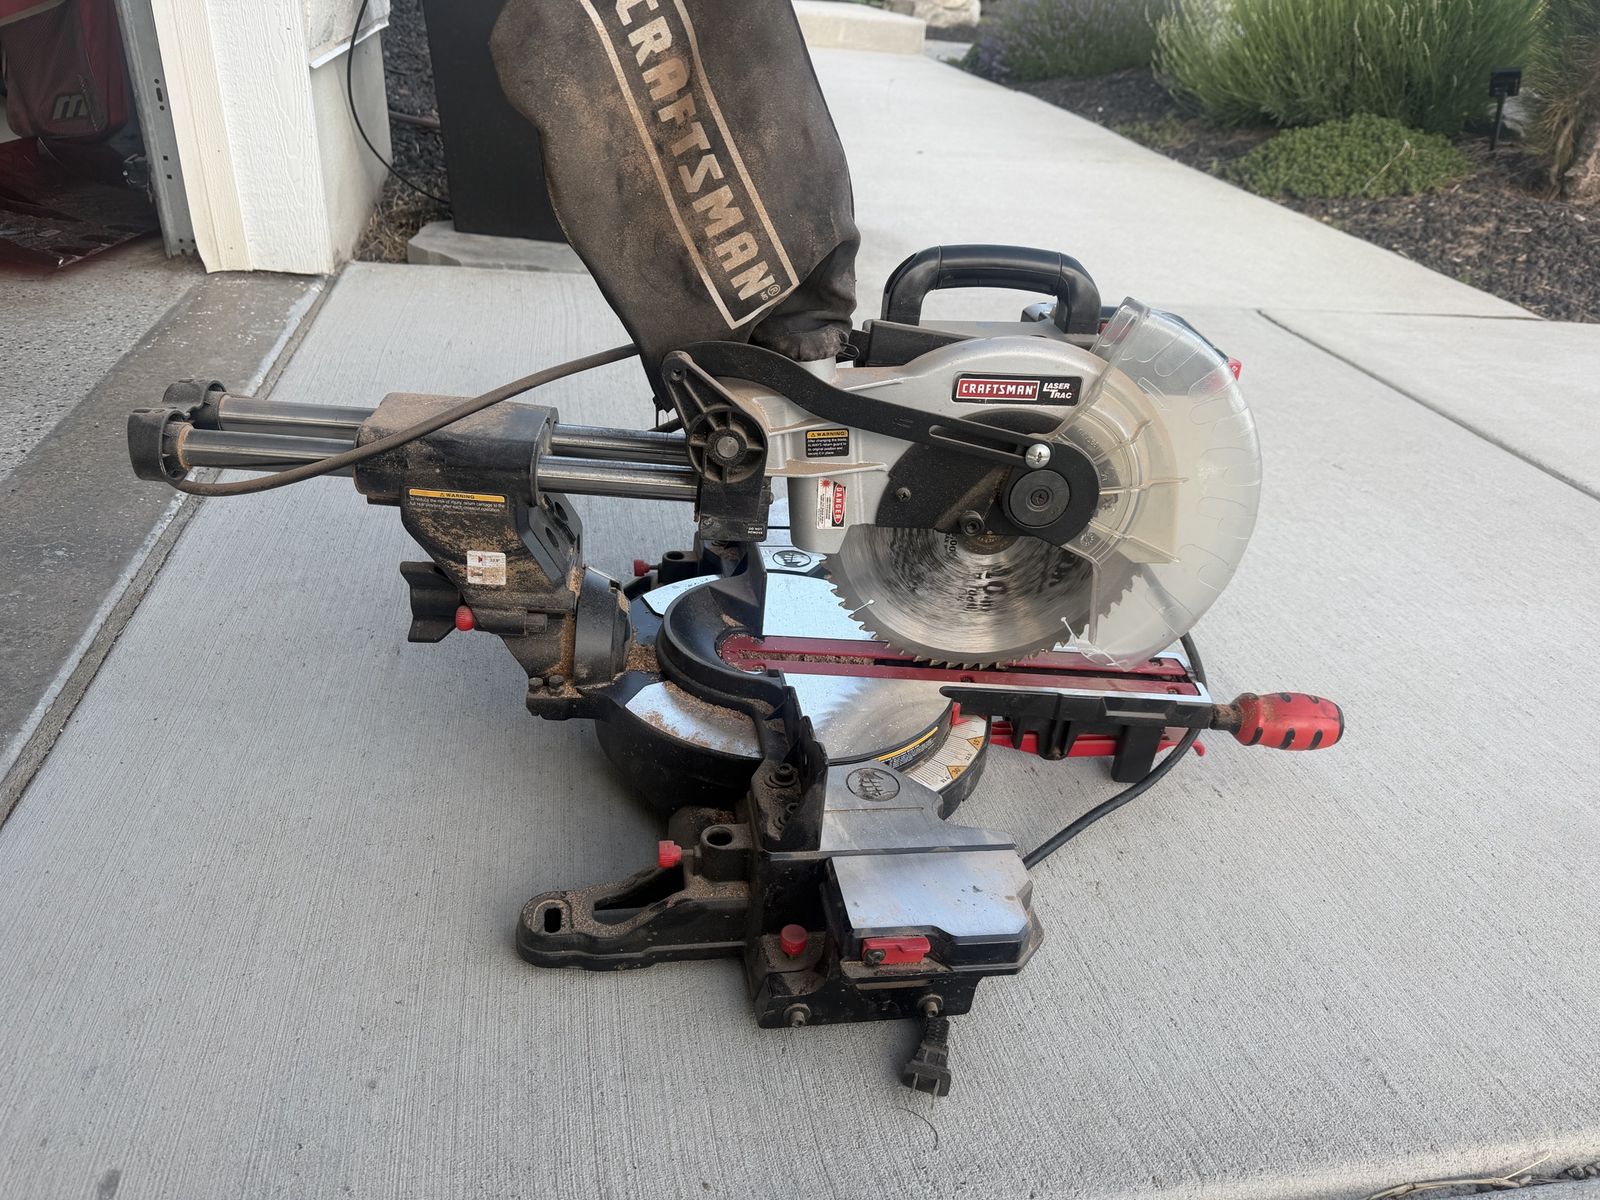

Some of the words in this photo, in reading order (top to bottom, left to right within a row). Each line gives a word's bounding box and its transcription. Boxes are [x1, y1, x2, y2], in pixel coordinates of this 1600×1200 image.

[962, 383, 1034, 396] CRAFTSMAN
[1043, 382, 1070, 391] LASER
[1049, 390, 1072, 399] TRAC
